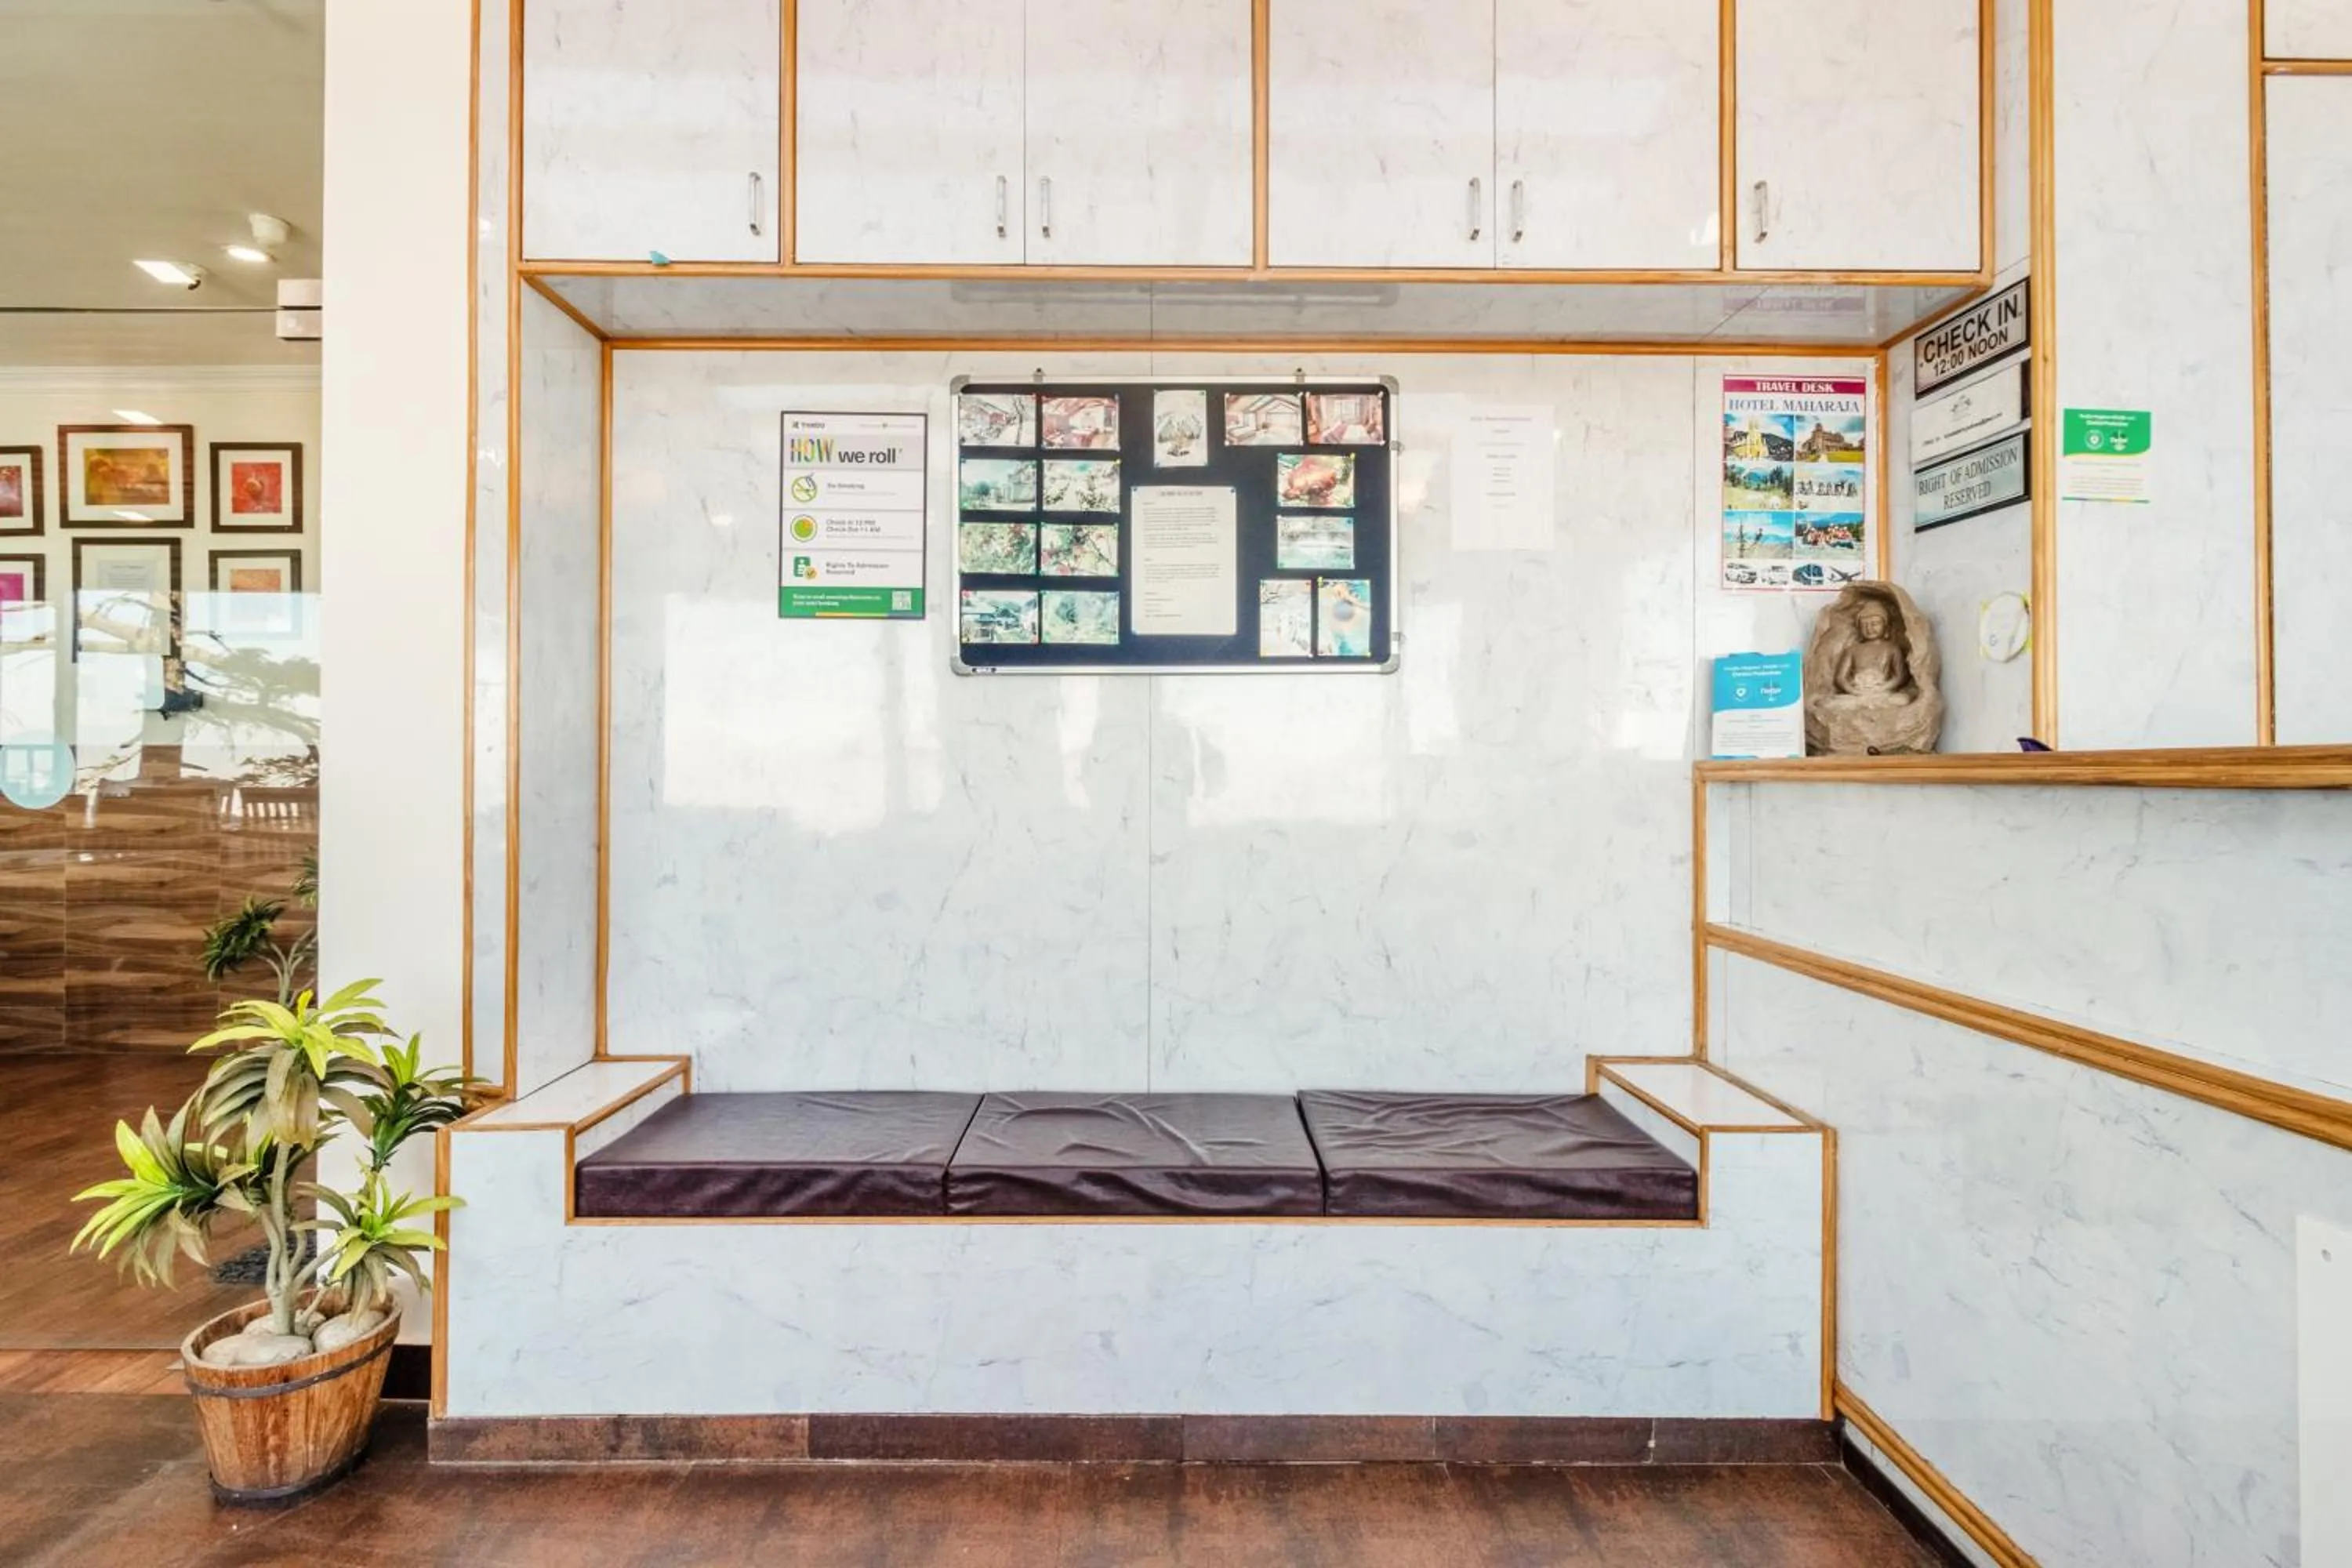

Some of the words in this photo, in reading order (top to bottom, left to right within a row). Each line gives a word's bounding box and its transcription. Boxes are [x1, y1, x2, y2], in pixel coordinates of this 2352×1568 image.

[1923, 310, 1992, 364] CHECK
[1998, 294, 2019, 325] IN
[1933, 351, 1964, 377] 12:00
[1969, 327, 2009, 358] NOON
[1756, 382, 1798, 392] TRAVEL
[1802, 382, 1835, 393] DESK
[1730, 399, 1778, 410] HOTEL
[1783, 398, 1860, 412] MAHARAJA
[790, 437, 834, 463] HOW
[839, 450, 866, 463] we
[869, 448, 896, 463] roll
[1918, 469, 1947, 496] RIGHT
[1951, 466, 1964, 484] OF
[1964, 447, 2019, 480] ADMISSION
[1944, 481, 1992, 510] RESERVED
